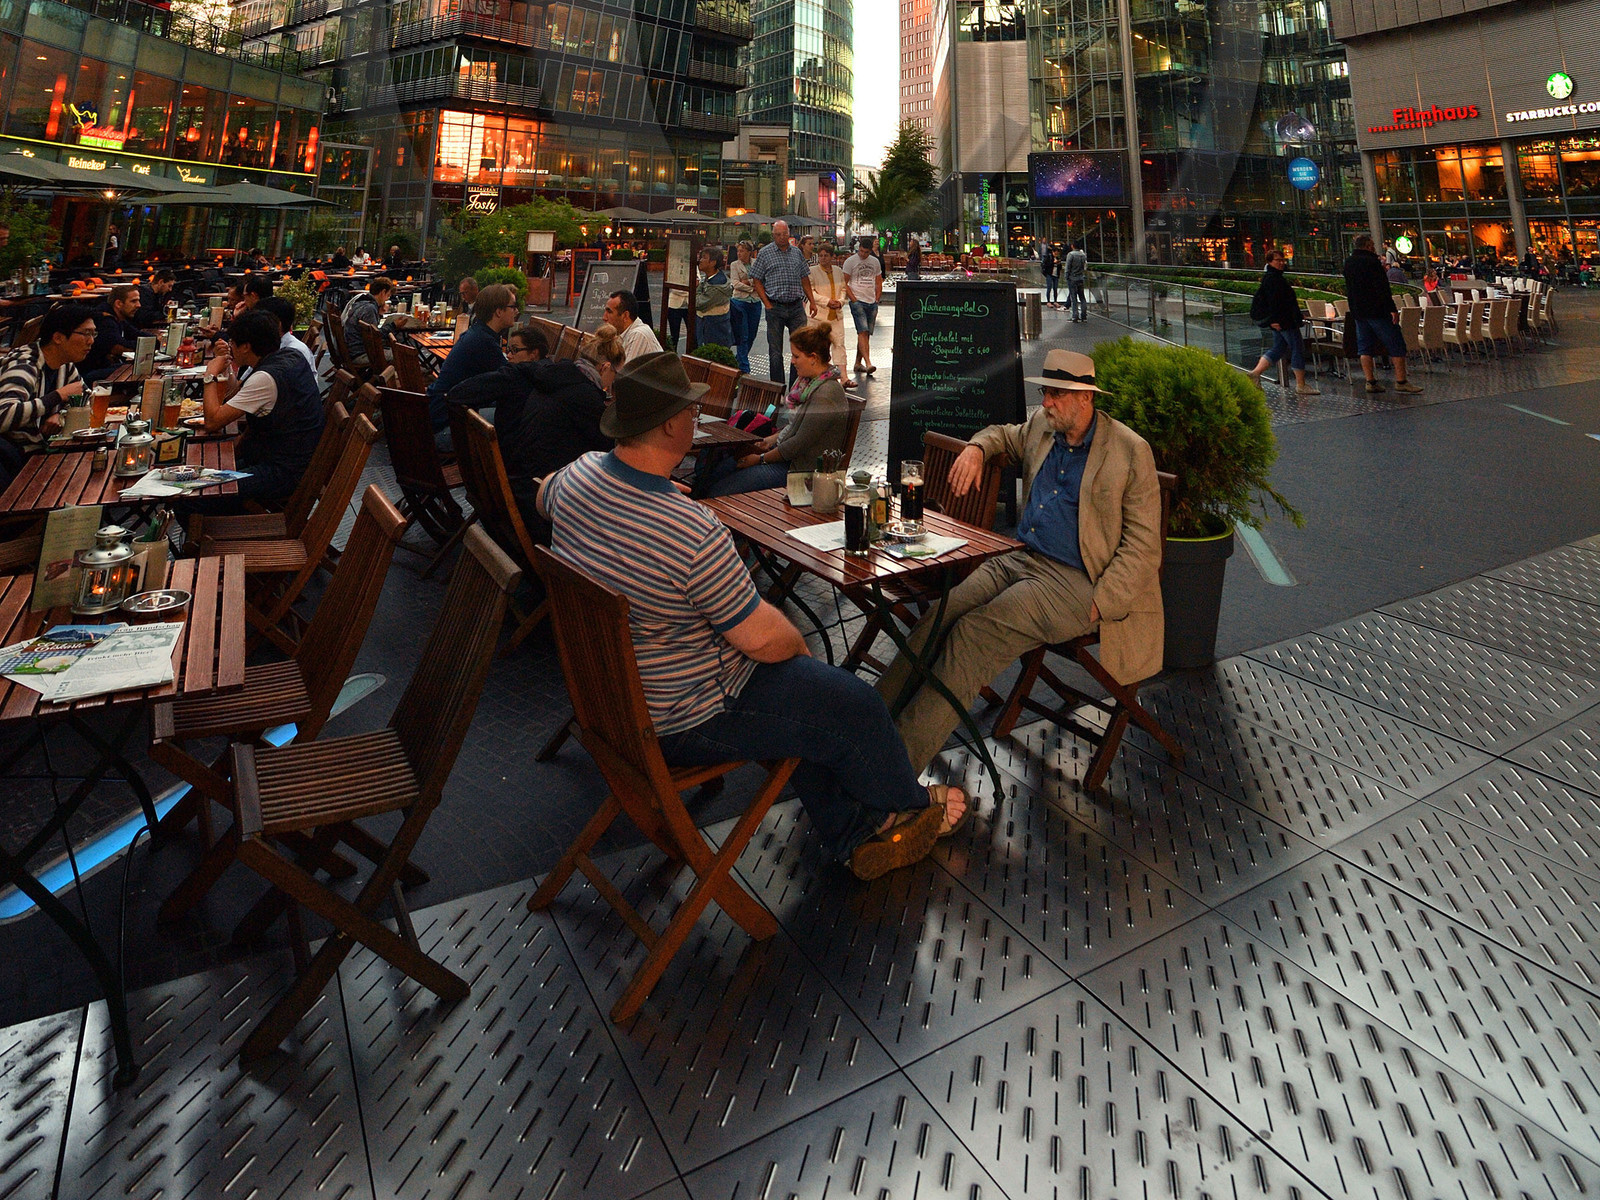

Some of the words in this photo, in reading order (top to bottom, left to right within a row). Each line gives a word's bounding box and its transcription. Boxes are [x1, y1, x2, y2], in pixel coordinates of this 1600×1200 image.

[1392, 104, 1479, 123] Filmhaus
[1505, 104, 1578, 122] STARBUCKS
[68, 156, 106, 171] Heineken
[132, 164, 151, 176] CAFÉ
[465, 193, 498, 216] Josty
[961, 334, 973, 343] mit
[931, 345, 963, 359] Baguette
